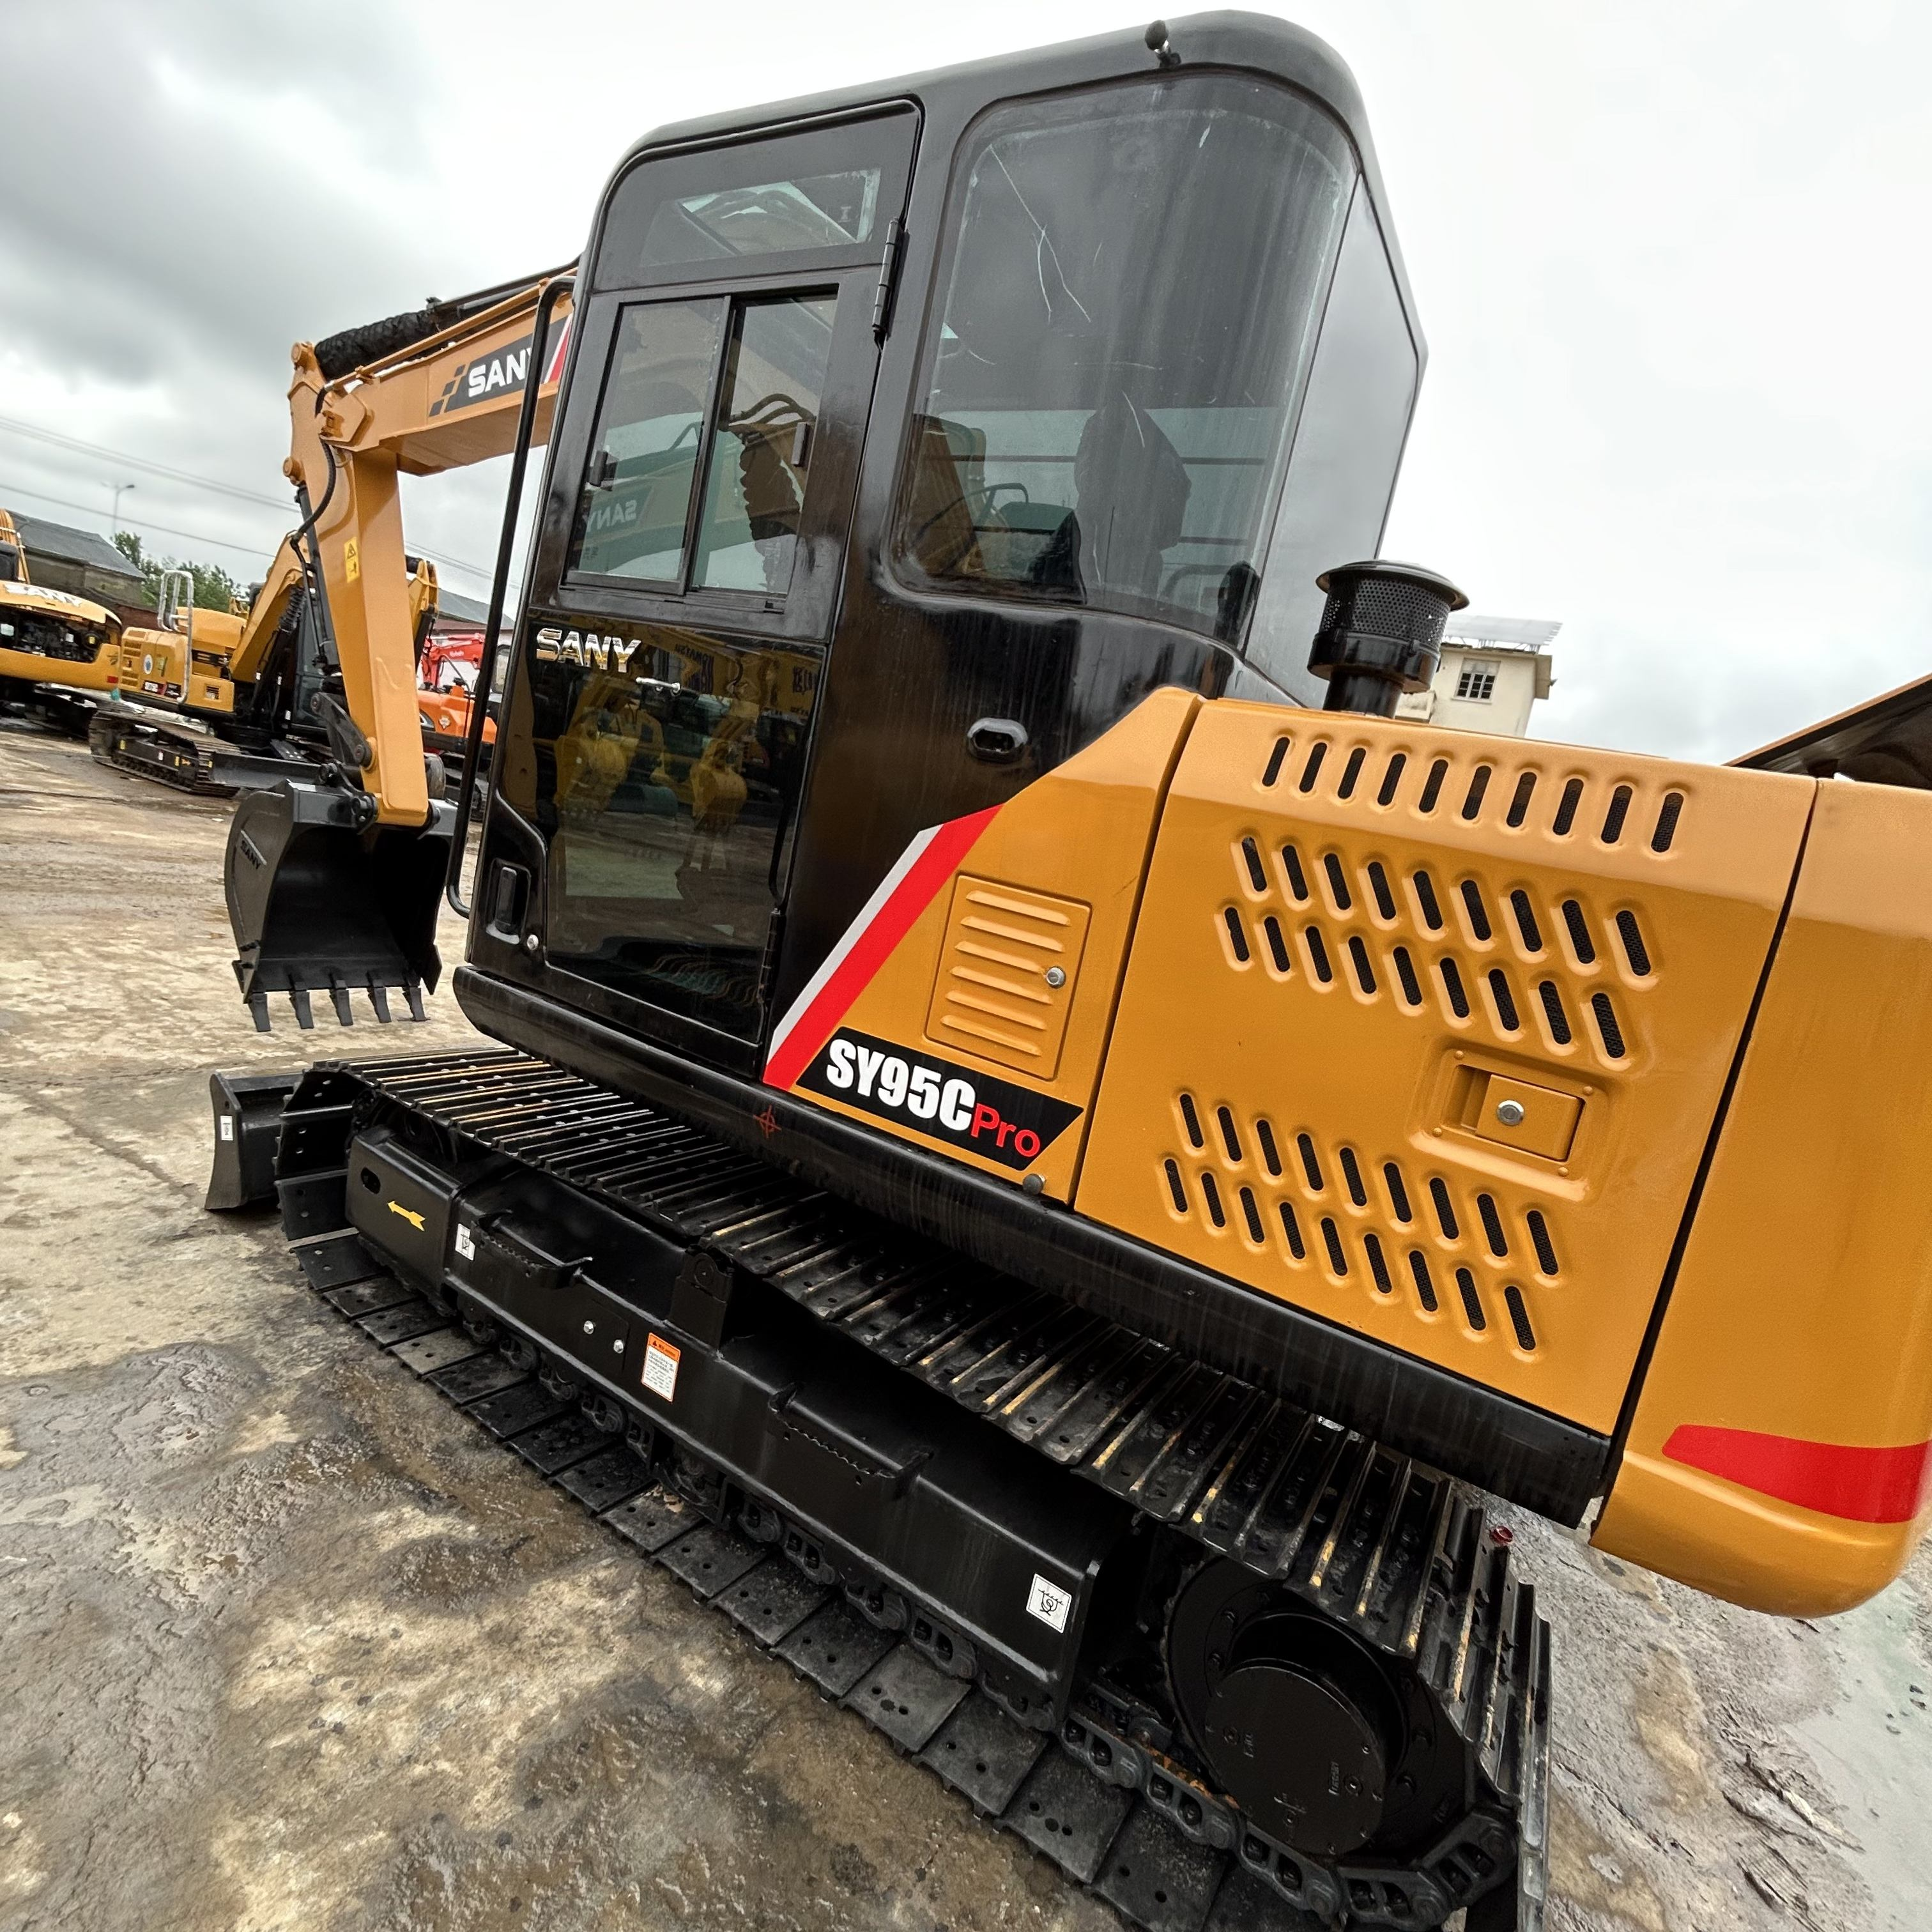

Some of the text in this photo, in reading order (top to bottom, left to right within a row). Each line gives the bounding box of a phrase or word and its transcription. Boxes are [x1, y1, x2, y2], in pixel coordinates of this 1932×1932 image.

[468, 348, 532, 397] SAN
[536, 627, 642, 673] SANY
[240, 840, 261, 869] SANY
